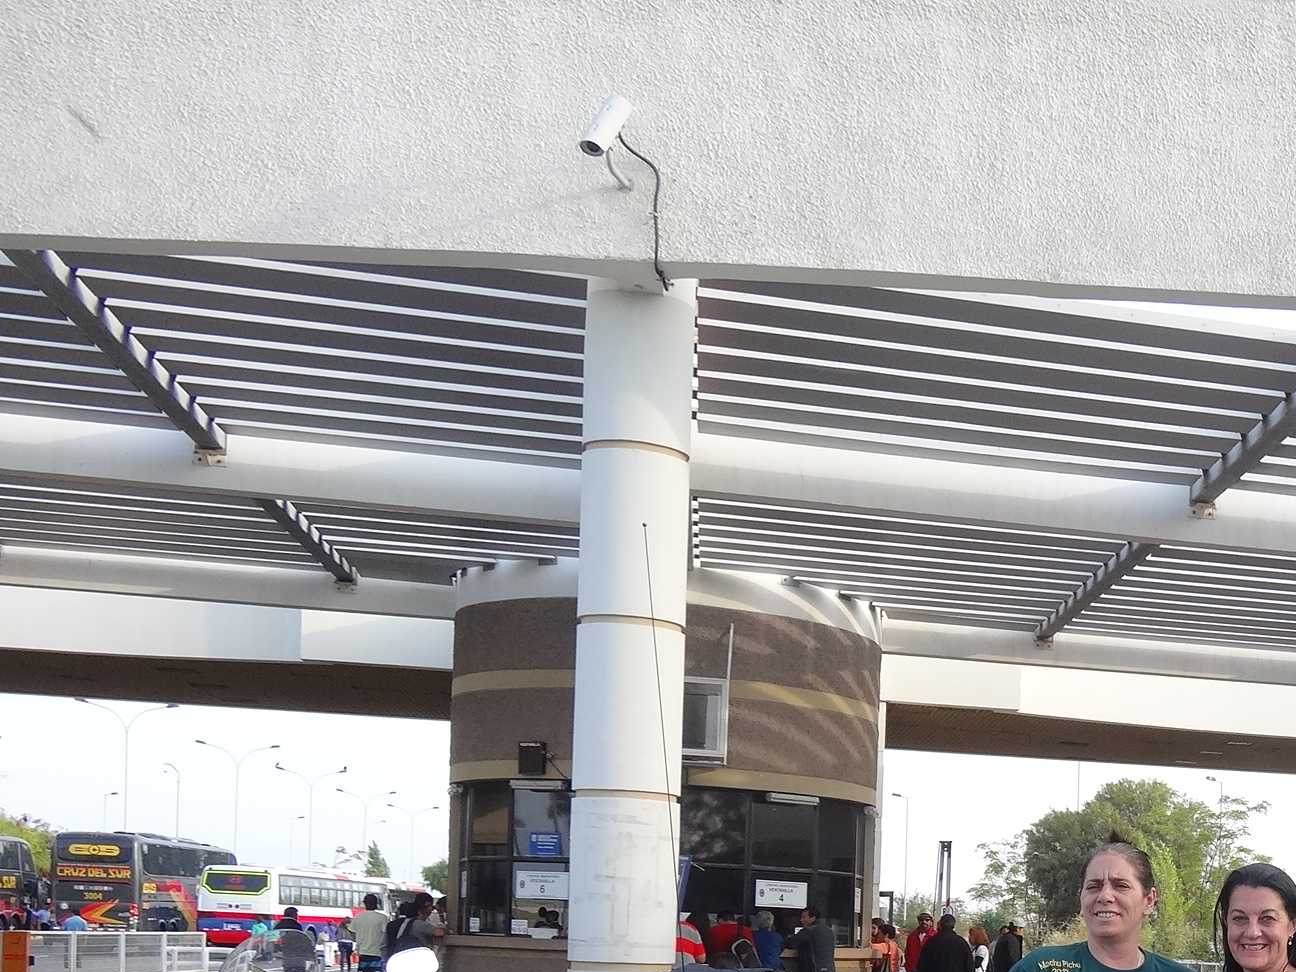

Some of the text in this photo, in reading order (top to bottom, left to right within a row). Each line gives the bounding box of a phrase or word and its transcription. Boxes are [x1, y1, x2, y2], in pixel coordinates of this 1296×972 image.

[57, 867, 131, 879] CRUZ DEL SUR
[778, 893, 785, 903] 4
